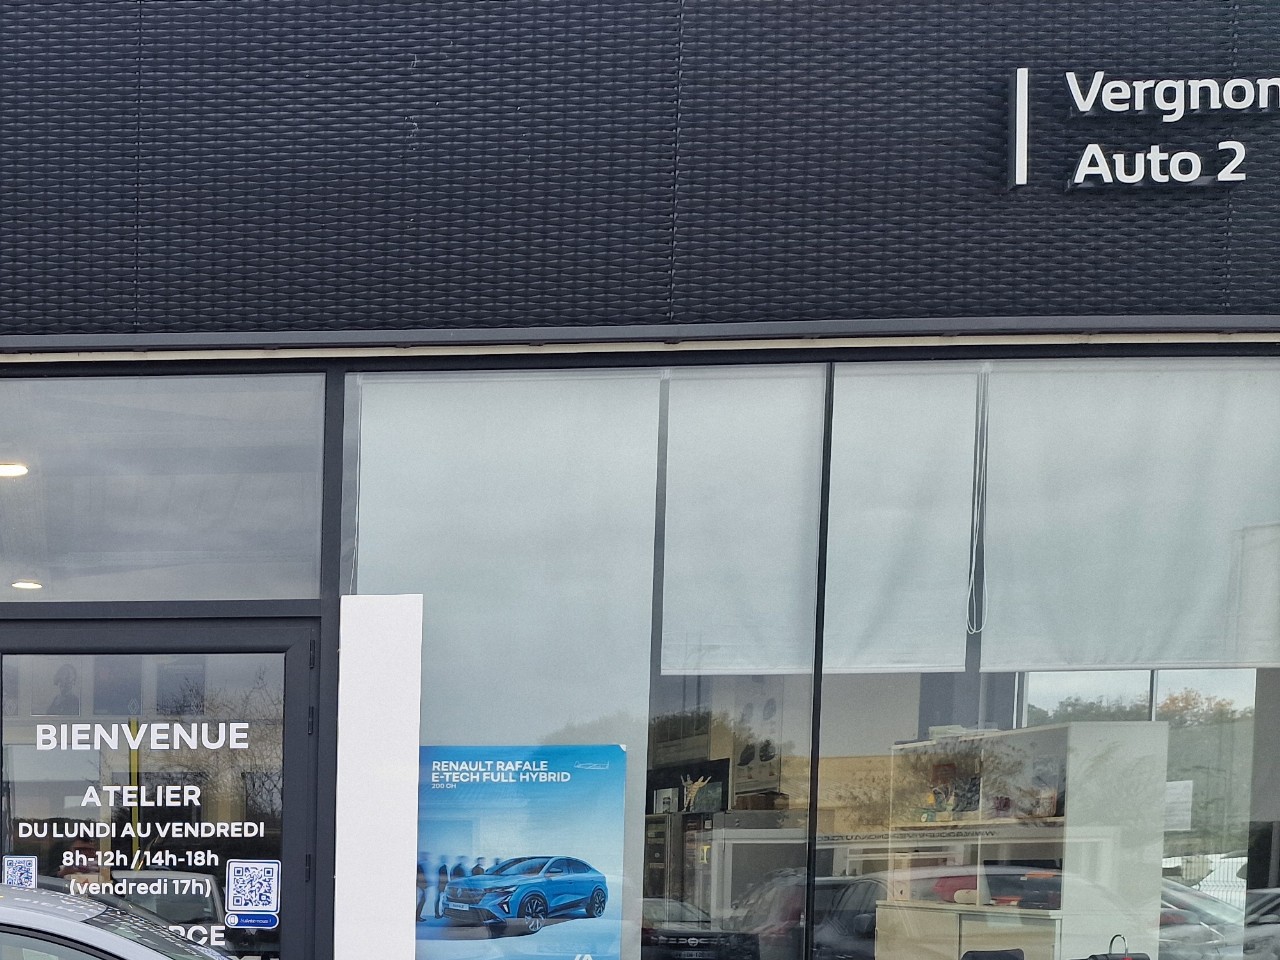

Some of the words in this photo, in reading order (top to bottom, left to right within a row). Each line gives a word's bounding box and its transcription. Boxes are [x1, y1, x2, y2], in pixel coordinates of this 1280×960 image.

[1066, 70, 1280, 122] Vergnon
[1073, 143, 1202, 184] Auto
[1217, 140, 1246, 181] 2
[36, 722, 249, 750] BIENVENUE
[432, 760, 493, 771] RENAULT
[496, 760, 548, 771] RAFALE
[431, 772, 480, 783] E-TECH
[482, 772, 516, 783] FULL
[520, 772, 571, 783] HYBRID
[81, 785, 201, 807] ATELIER
[18, 822, 48, 838] DU
[52, 822, 116, 838] LUNDI
[120, 822, 151, 838] AU
[155, 822, 265, 838] VENDREDI
[69, 878, 168, 897] (vendredi
[172, 878, 212, 897] 17h)
